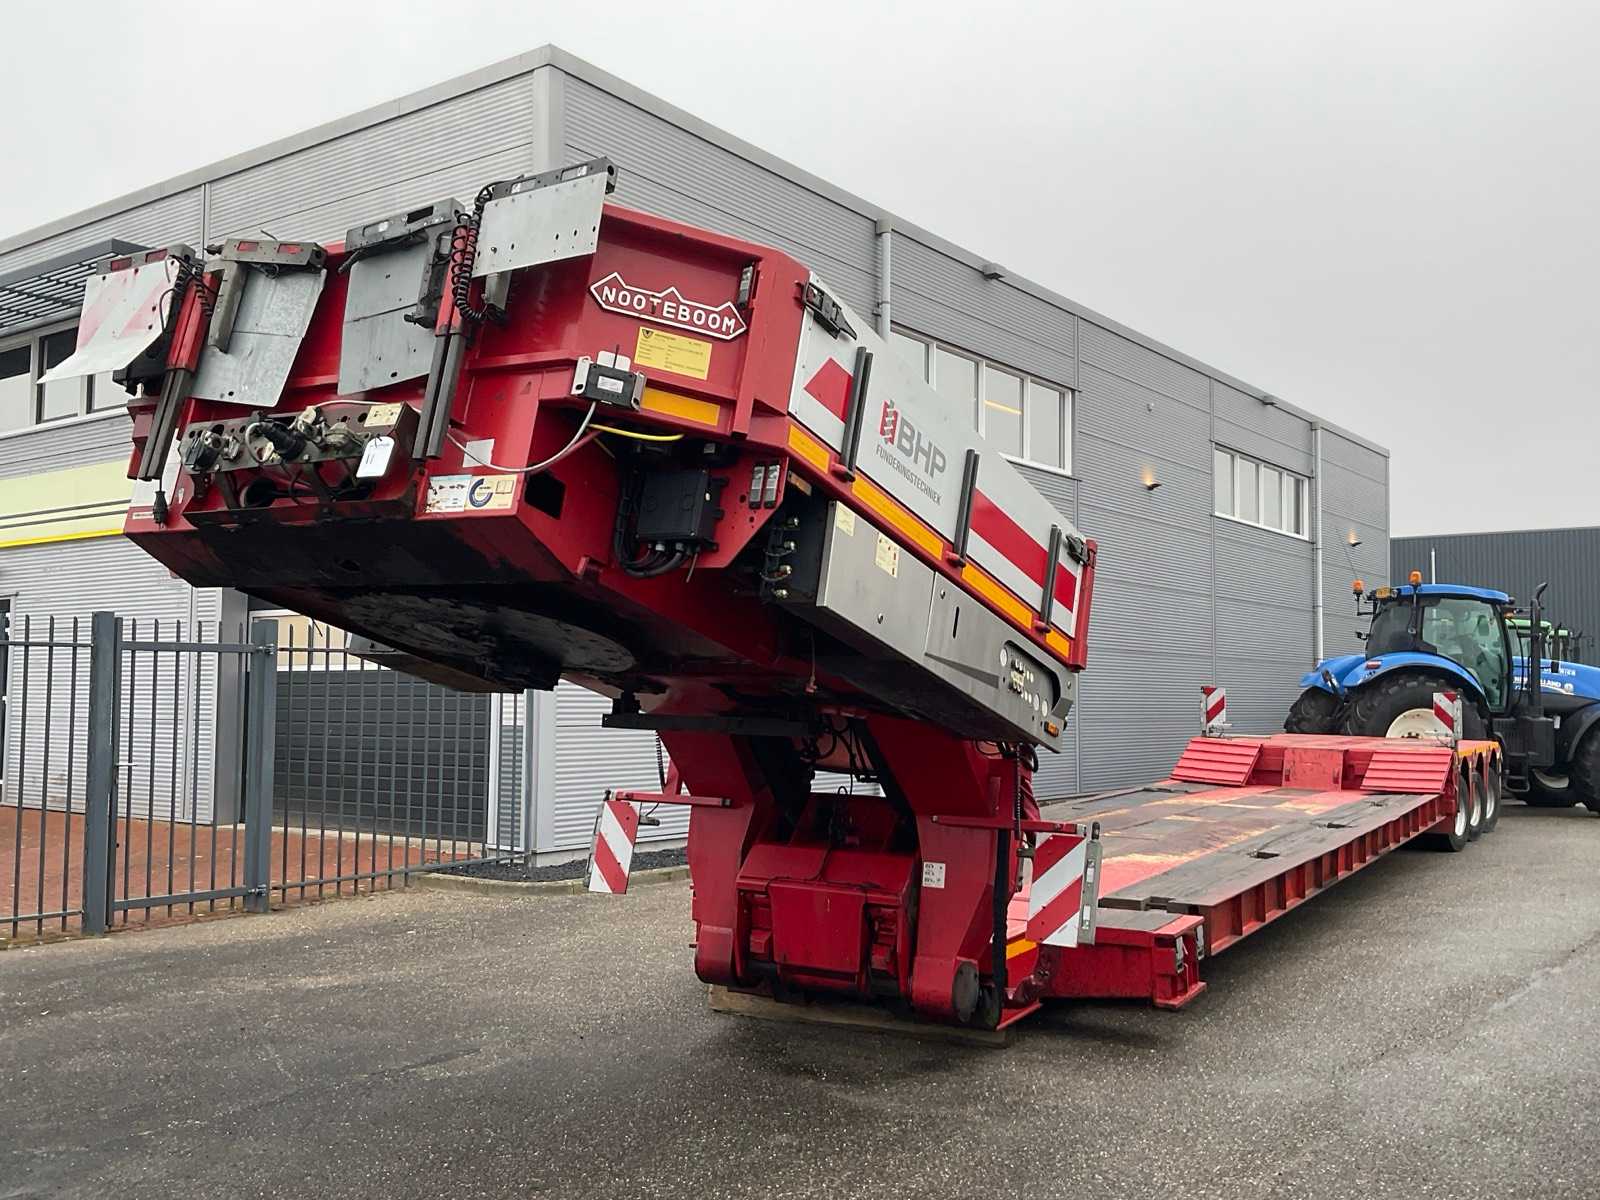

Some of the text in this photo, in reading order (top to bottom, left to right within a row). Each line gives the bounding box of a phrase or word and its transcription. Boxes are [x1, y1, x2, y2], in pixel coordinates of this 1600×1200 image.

[602, 286, 736, 334] NOOTEBOOM
[876, 444, 942, 505] FUNDERINGSTECHNIEK
[897, 417, 946, 479] BHP
